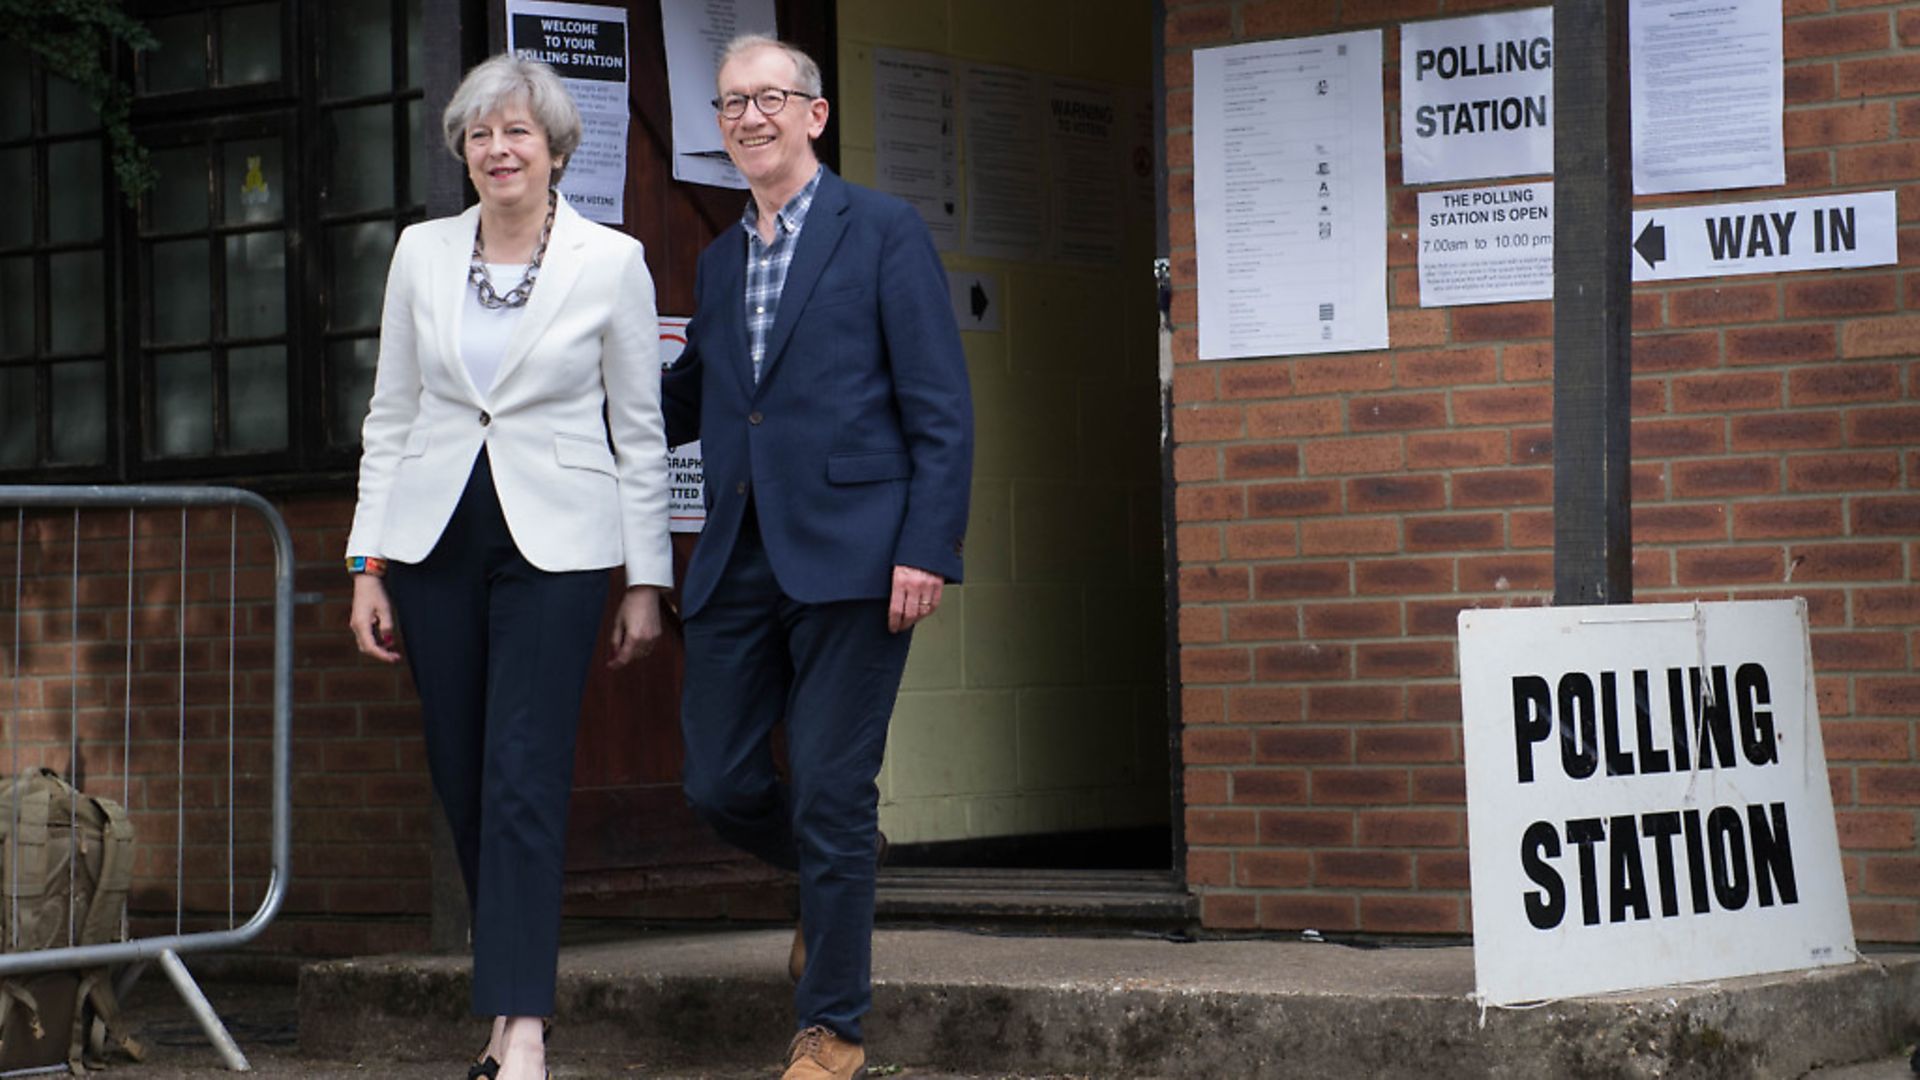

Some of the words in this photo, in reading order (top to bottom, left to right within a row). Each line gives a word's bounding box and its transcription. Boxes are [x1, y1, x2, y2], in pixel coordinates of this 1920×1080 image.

[541, 19, 599, 35] WELCOME
[544, 35, 561, 48] TO
[563, 37, 597, 51] YOUR
[515, 49, 569, 65] POLLING
[571, 53, 623, 68] STATION
[1416, 36, 1551, 81] POLLING
[1051, 99, 1113, 125] WARNING
[1416, 95, 1547, 137] STATION
[1058, 119, 1071, 132] TO
[586, 195, 615, 207] VOTING
[1443, 193, 1470, 207] THE
[1472, 188, 1534, 205] POLLING
[1430, 210, 1489, 227] STATION
[1493, 208, 1506, 223] IS
[1509, 206, 1548, 222] OPEN
[1475, 238, 1488, 250] to
[1496, 233, 1529, 249] 10.00
[1532, 235, 1552, 248] pm
[1705, 211, 1797, 261] WAY
[1814, 207, 1857, 254] IN
[675, 472, 704, 484] KIND
[1511, 662, 1779, 784] POLLING
[1520, 801, 1799, 931] STATION
